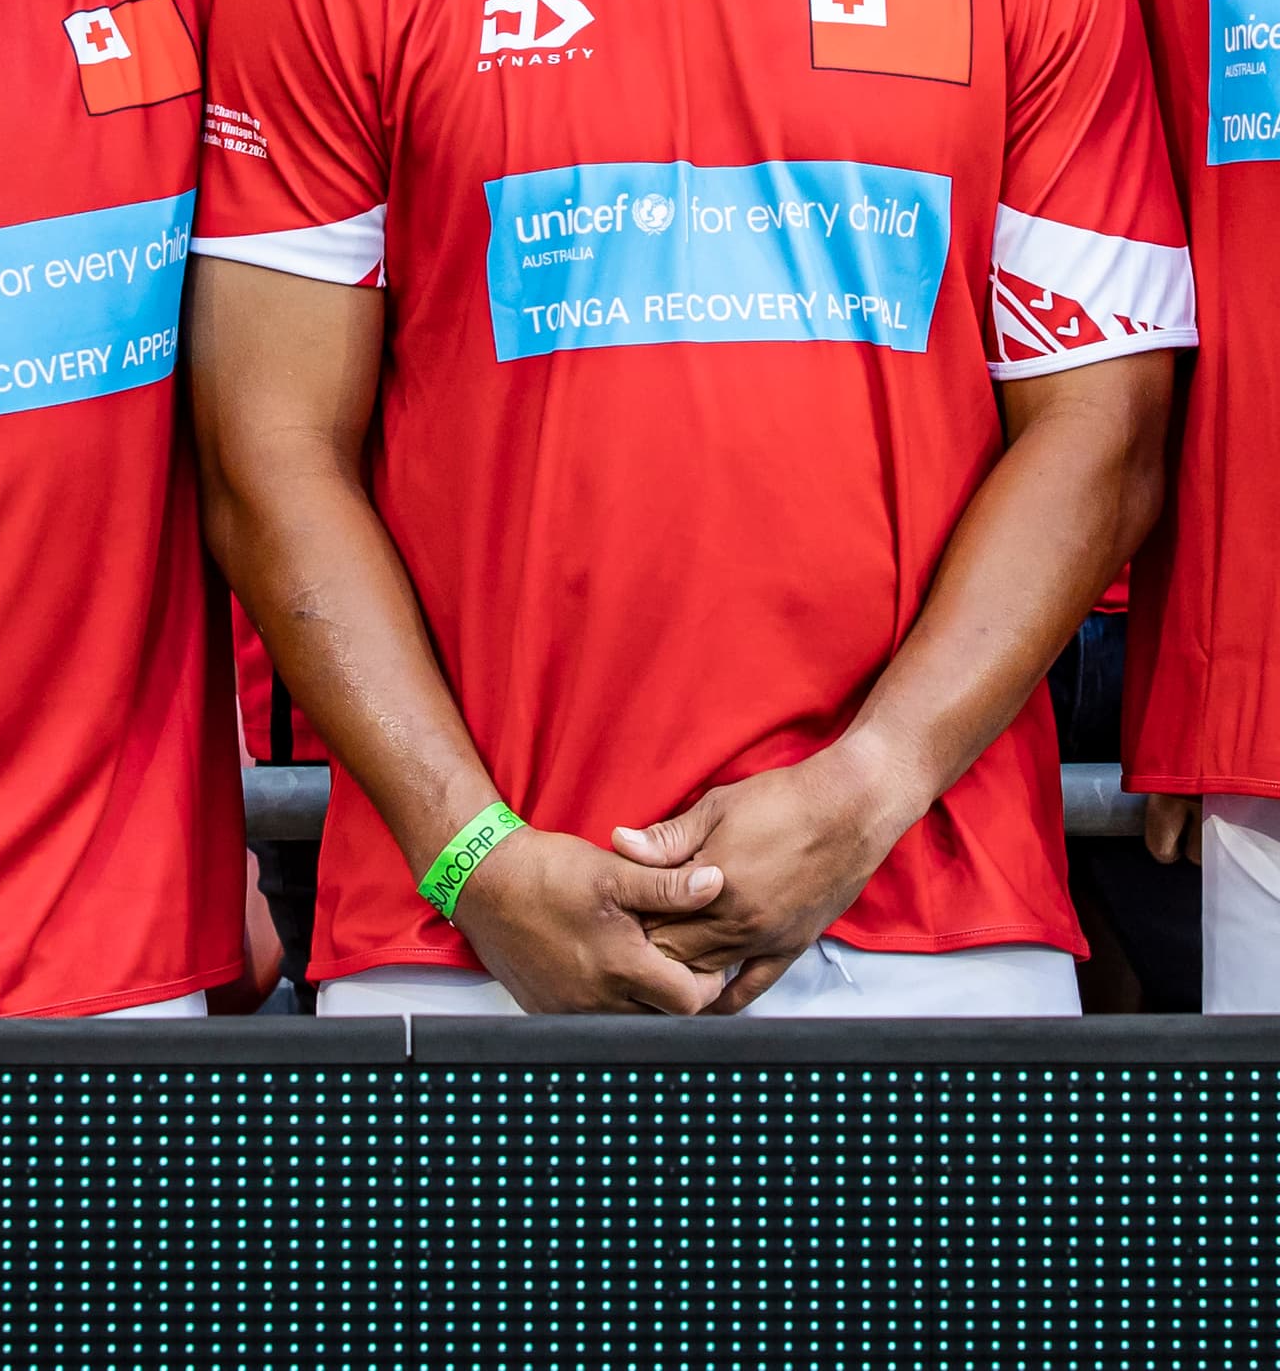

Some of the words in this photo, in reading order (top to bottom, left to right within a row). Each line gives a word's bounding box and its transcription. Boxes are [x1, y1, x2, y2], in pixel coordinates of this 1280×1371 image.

[477, 48, 594, 73] DYNASTY
[1224, 62, 1267, 78] AUSTRALIA
[515, 193, 629, 244] unicef
[690, 195, 737, 233] for
[746, 200, 840, 238] every
[849, 195, 919, 239] child
[45, 245, 138, 289] every
[145, 222, 189, 273] child
[522, 246, 594, 269] AUSTRALIA
[523, 297, 631, 334] TONGA
[644, 292, 818, 323] RECOVERY
